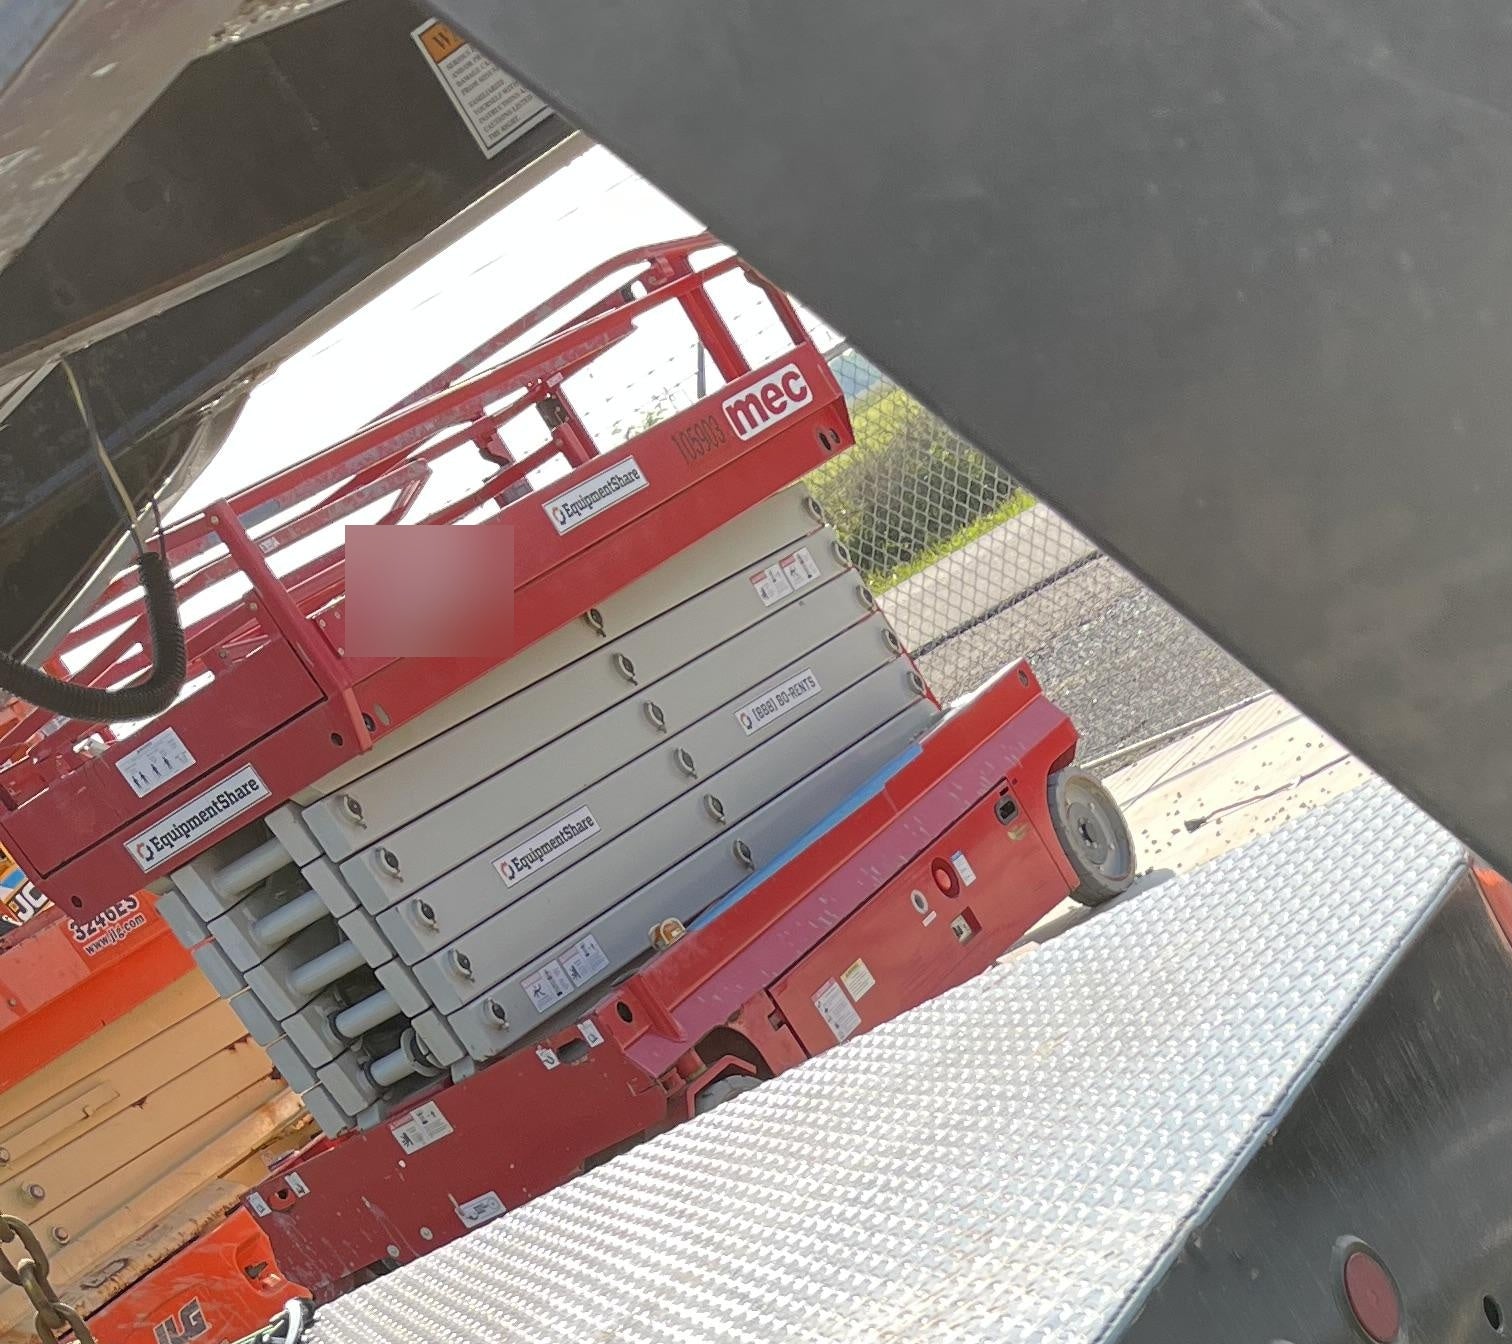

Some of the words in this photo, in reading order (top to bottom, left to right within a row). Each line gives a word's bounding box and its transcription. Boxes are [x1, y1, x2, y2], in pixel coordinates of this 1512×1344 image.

[726, 371, 807, 435] mec
[563, 465, 640, 518] EquipmentShare
[149, 778, 259, 851] EquipmentShare
[511, 816, 594, 872] EquipmentShare
[14, 881, 48, 924] JC
[85, 914, 145, 955] www.jlg.com
